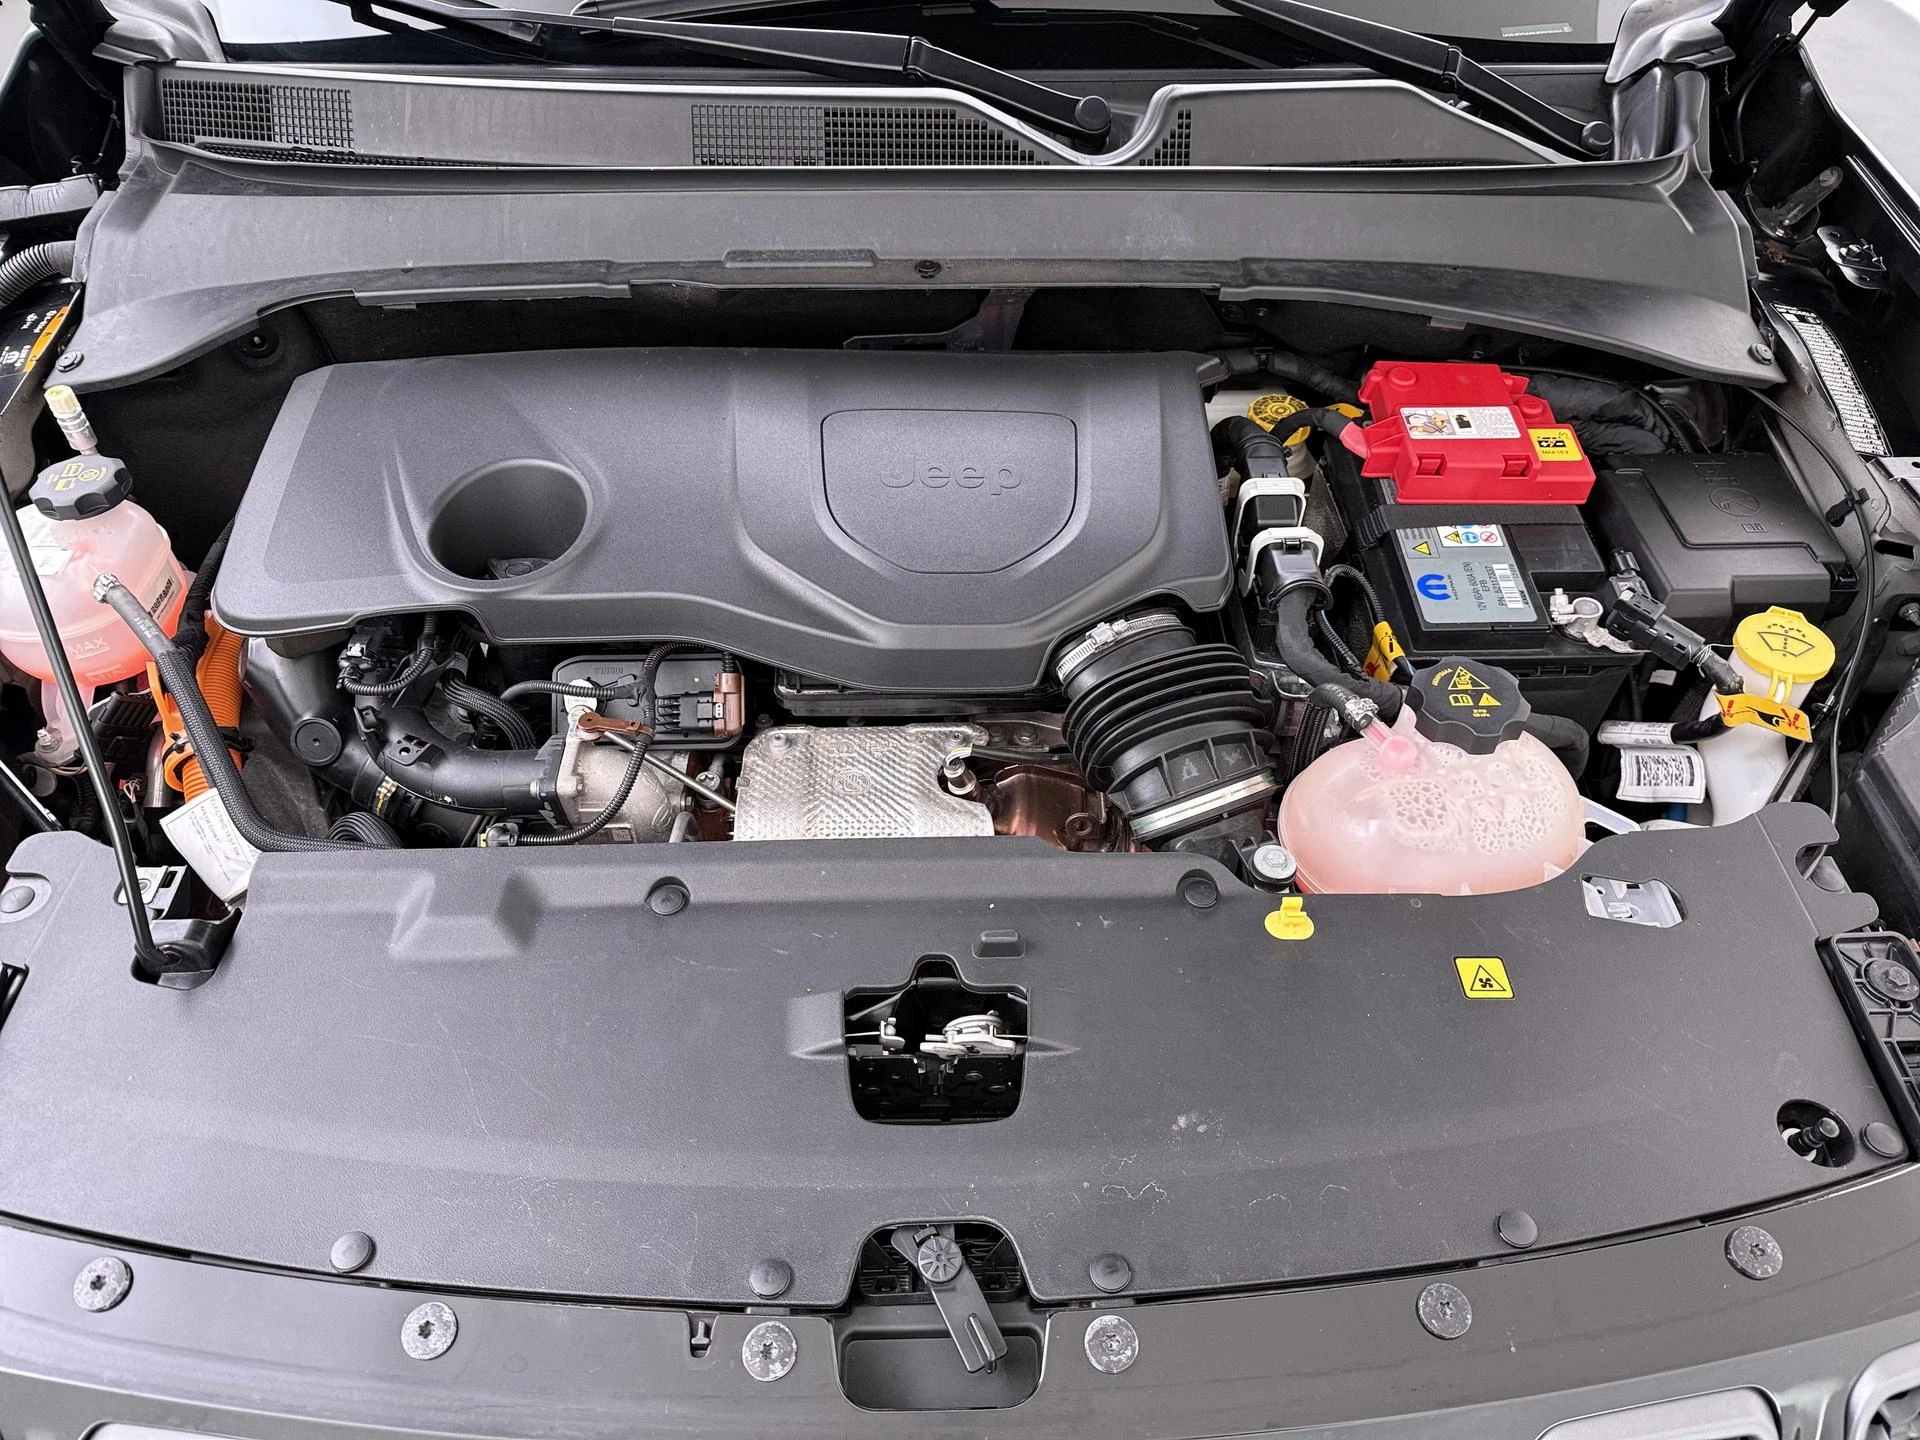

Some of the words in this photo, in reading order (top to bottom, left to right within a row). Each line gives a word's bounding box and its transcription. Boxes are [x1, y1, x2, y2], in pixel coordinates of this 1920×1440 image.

[879, 454, 1023, 496] Jeep
[1447, 574, 1459, 600] MOPAR
[1477, 579, 1490, 591] EFB
[67, 636, 109, 656] MAX
